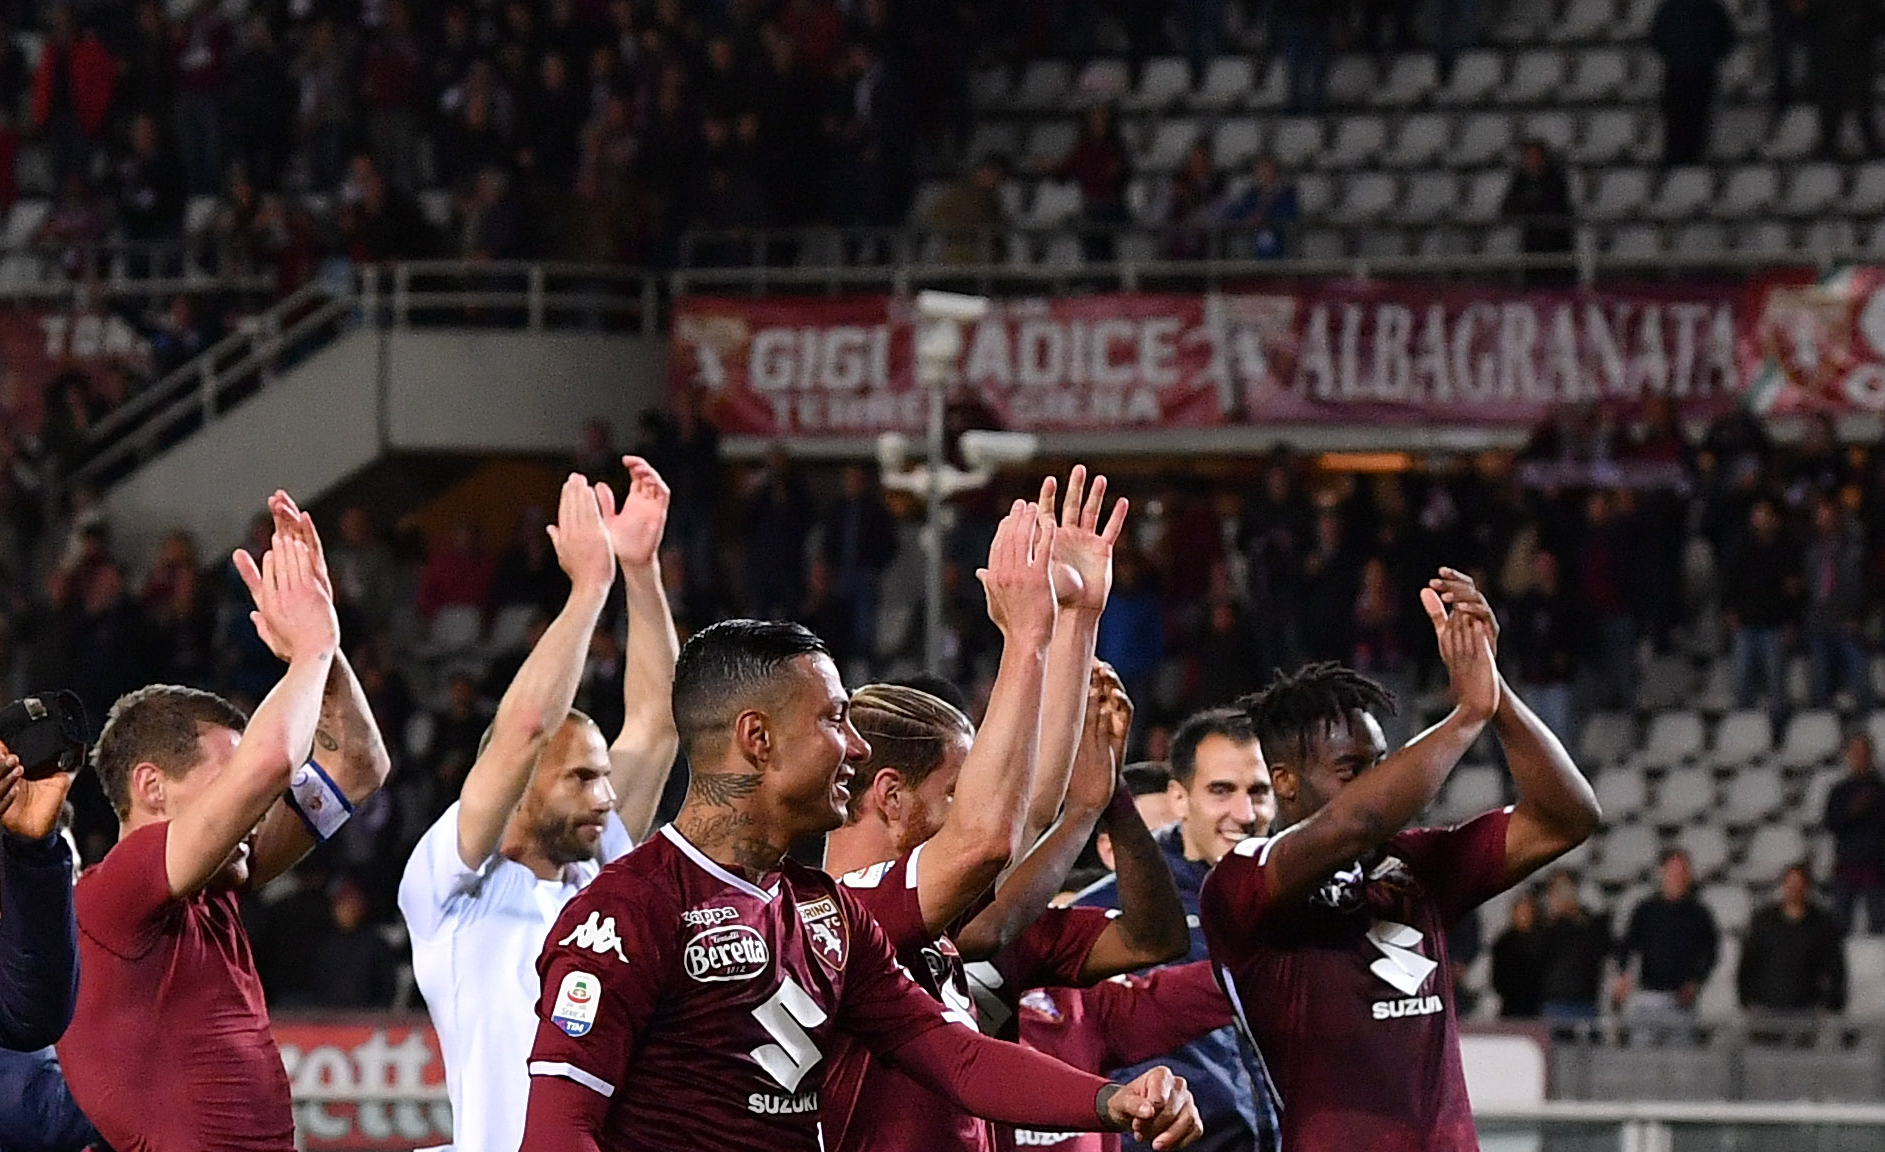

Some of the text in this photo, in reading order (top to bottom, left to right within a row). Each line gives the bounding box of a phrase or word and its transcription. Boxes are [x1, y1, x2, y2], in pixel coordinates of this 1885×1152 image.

[751, 319, 1183, 390] GIGI ADICE
[1301, 300, 1739, 400] ALBAGRANATA
[688, 936, 767, 977] Beretta
[566, 1021, 585, 1033] TIM
[747, 1092, 818, 1114] SUZUKI
